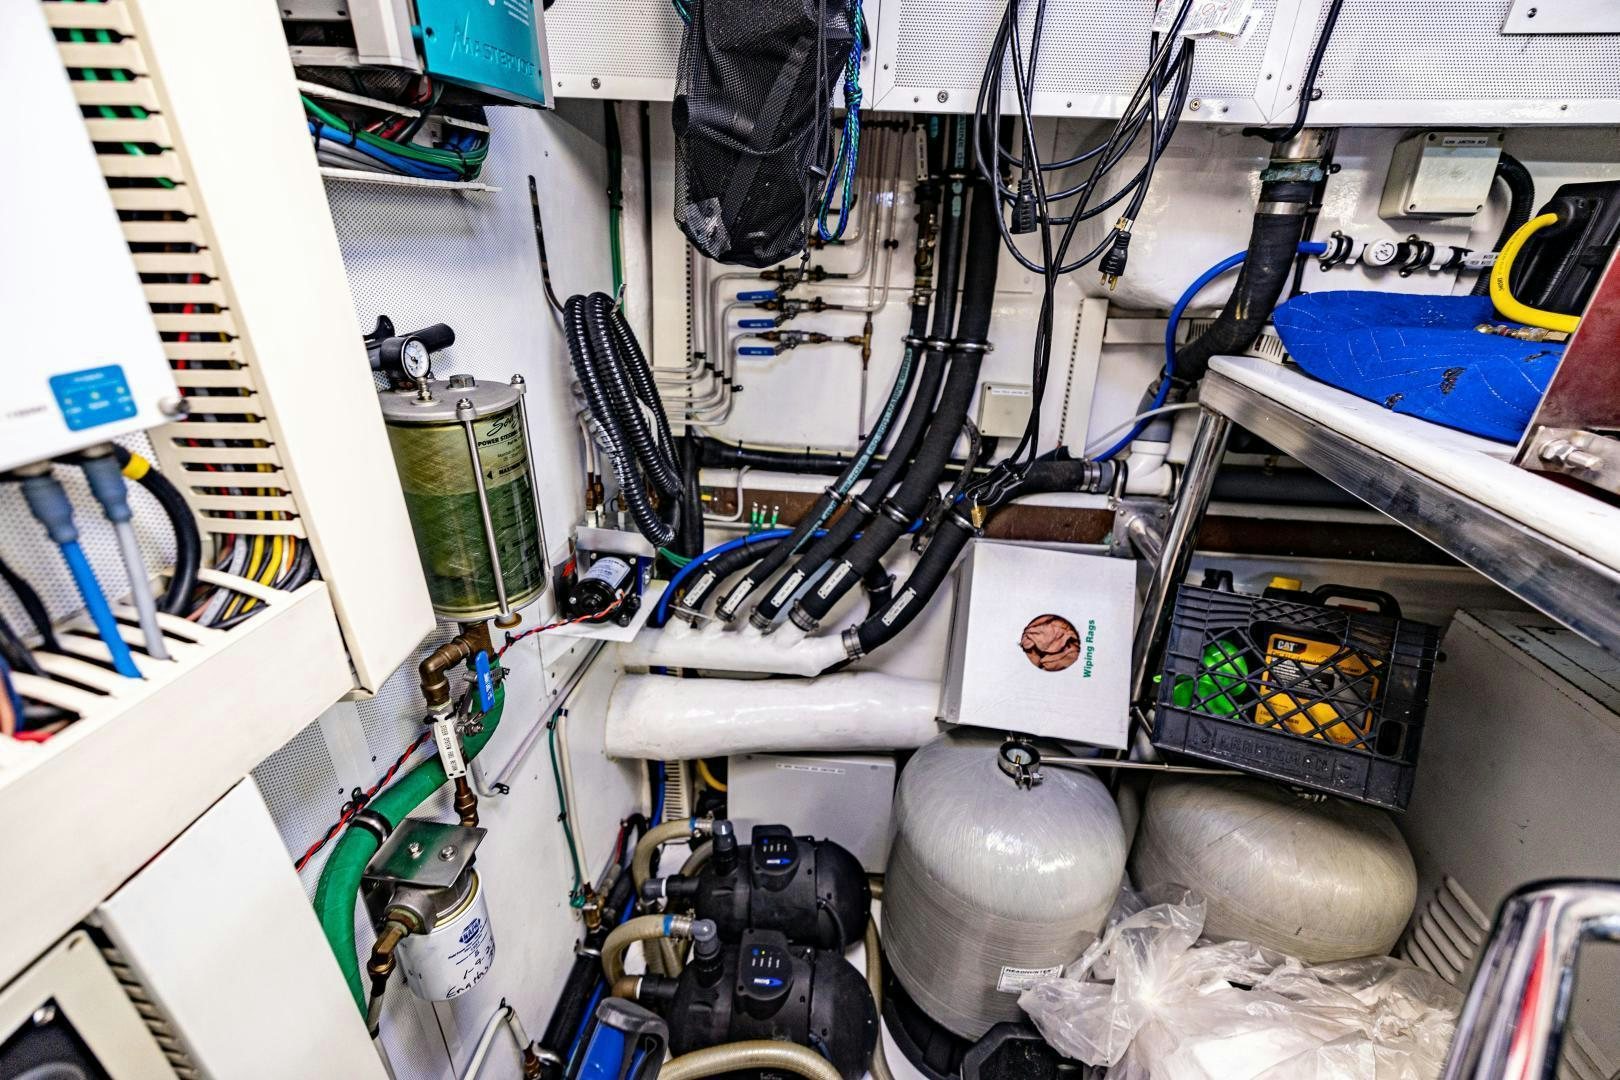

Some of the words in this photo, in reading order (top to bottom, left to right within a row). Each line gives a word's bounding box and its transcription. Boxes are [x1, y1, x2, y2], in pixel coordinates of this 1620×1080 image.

[478, 438, 499, 447] POWER
[1085, 620, 1096, 643] Rags
[1277, 641, 1296, 651] CAT
[1083, 646, 1095, 678] Wiping
